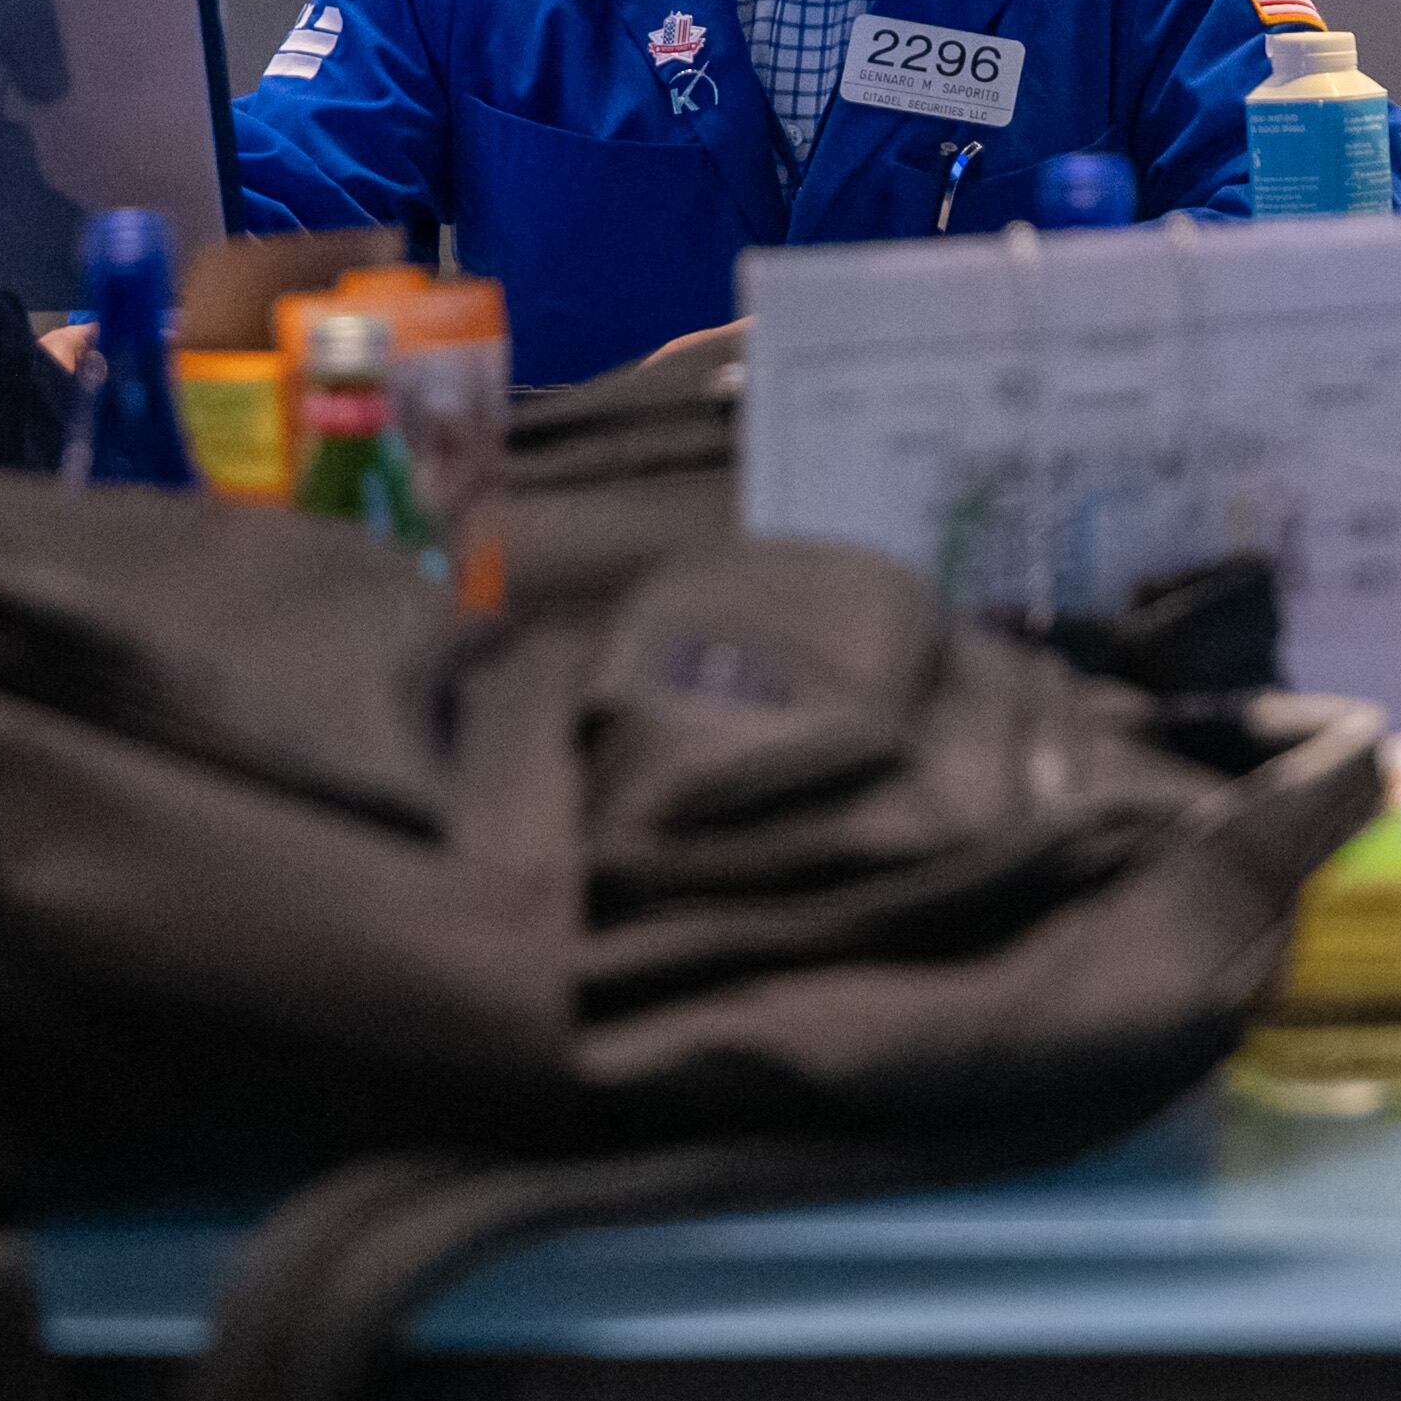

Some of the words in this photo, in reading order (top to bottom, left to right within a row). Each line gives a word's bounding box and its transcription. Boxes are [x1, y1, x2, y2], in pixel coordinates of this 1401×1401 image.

[867, 29, 1002, 83] 2296
[859, 69, 914, 88] GENNARO
[942, 82, 1000, 102] SAPORITO
[863, 91, 902, 107] CITADEL
[907, 99, 964, 117] SECURITIES
[969, 109, 988, 121] LLC
